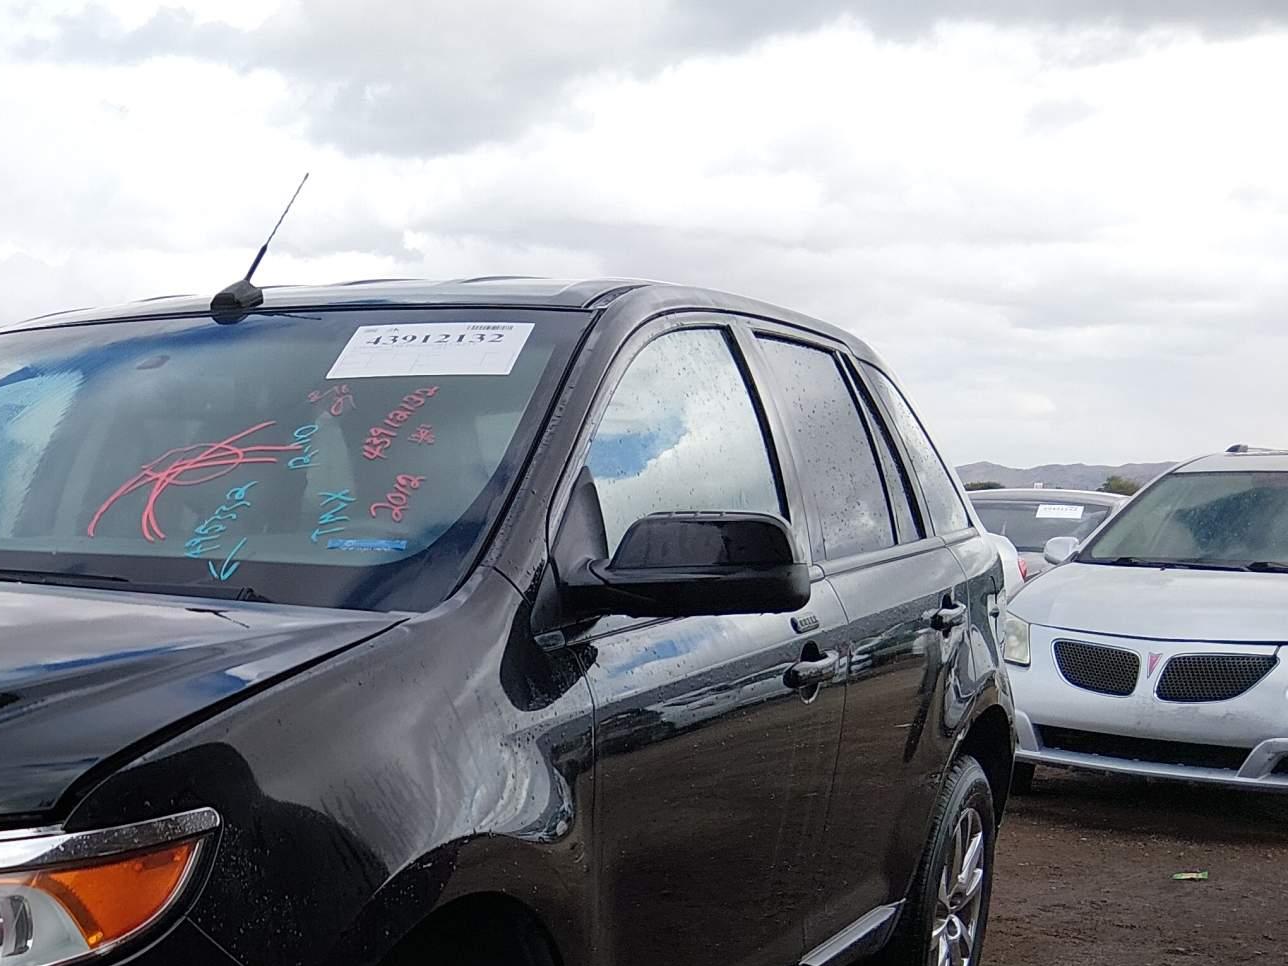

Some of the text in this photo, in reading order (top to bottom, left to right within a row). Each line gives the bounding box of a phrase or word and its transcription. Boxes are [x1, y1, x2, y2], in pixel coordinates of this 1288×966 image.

[365, 332, 505, 346] 43912132
[363, 386, 440, 460] 43912132
[370, 474, 427, 523] 2012
